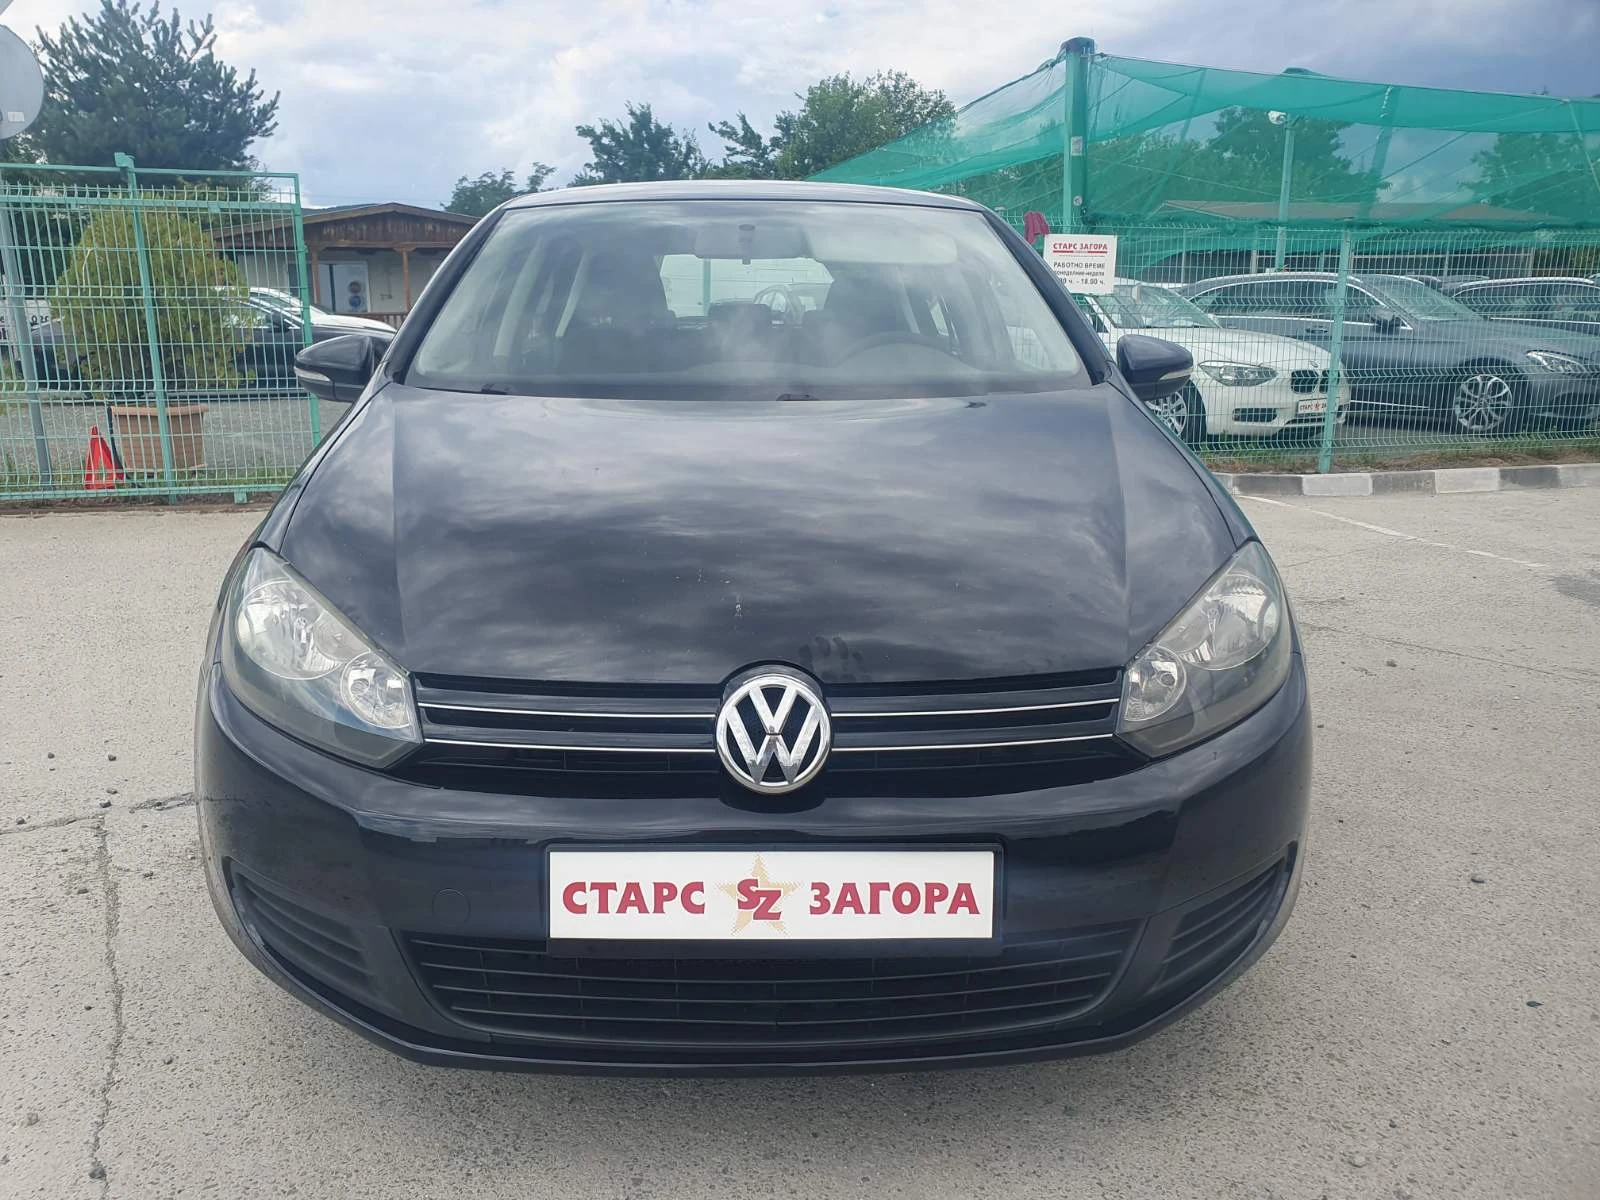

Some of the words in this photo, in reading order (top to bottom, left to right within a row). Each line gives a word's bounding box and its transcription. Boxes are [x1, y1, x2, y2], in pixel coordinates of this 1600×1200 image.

[562, 881, 705, 915] СТАРС
[737, 878, 782, 921] SZ
[809, 881, 981, 915] ЗАГОРА
